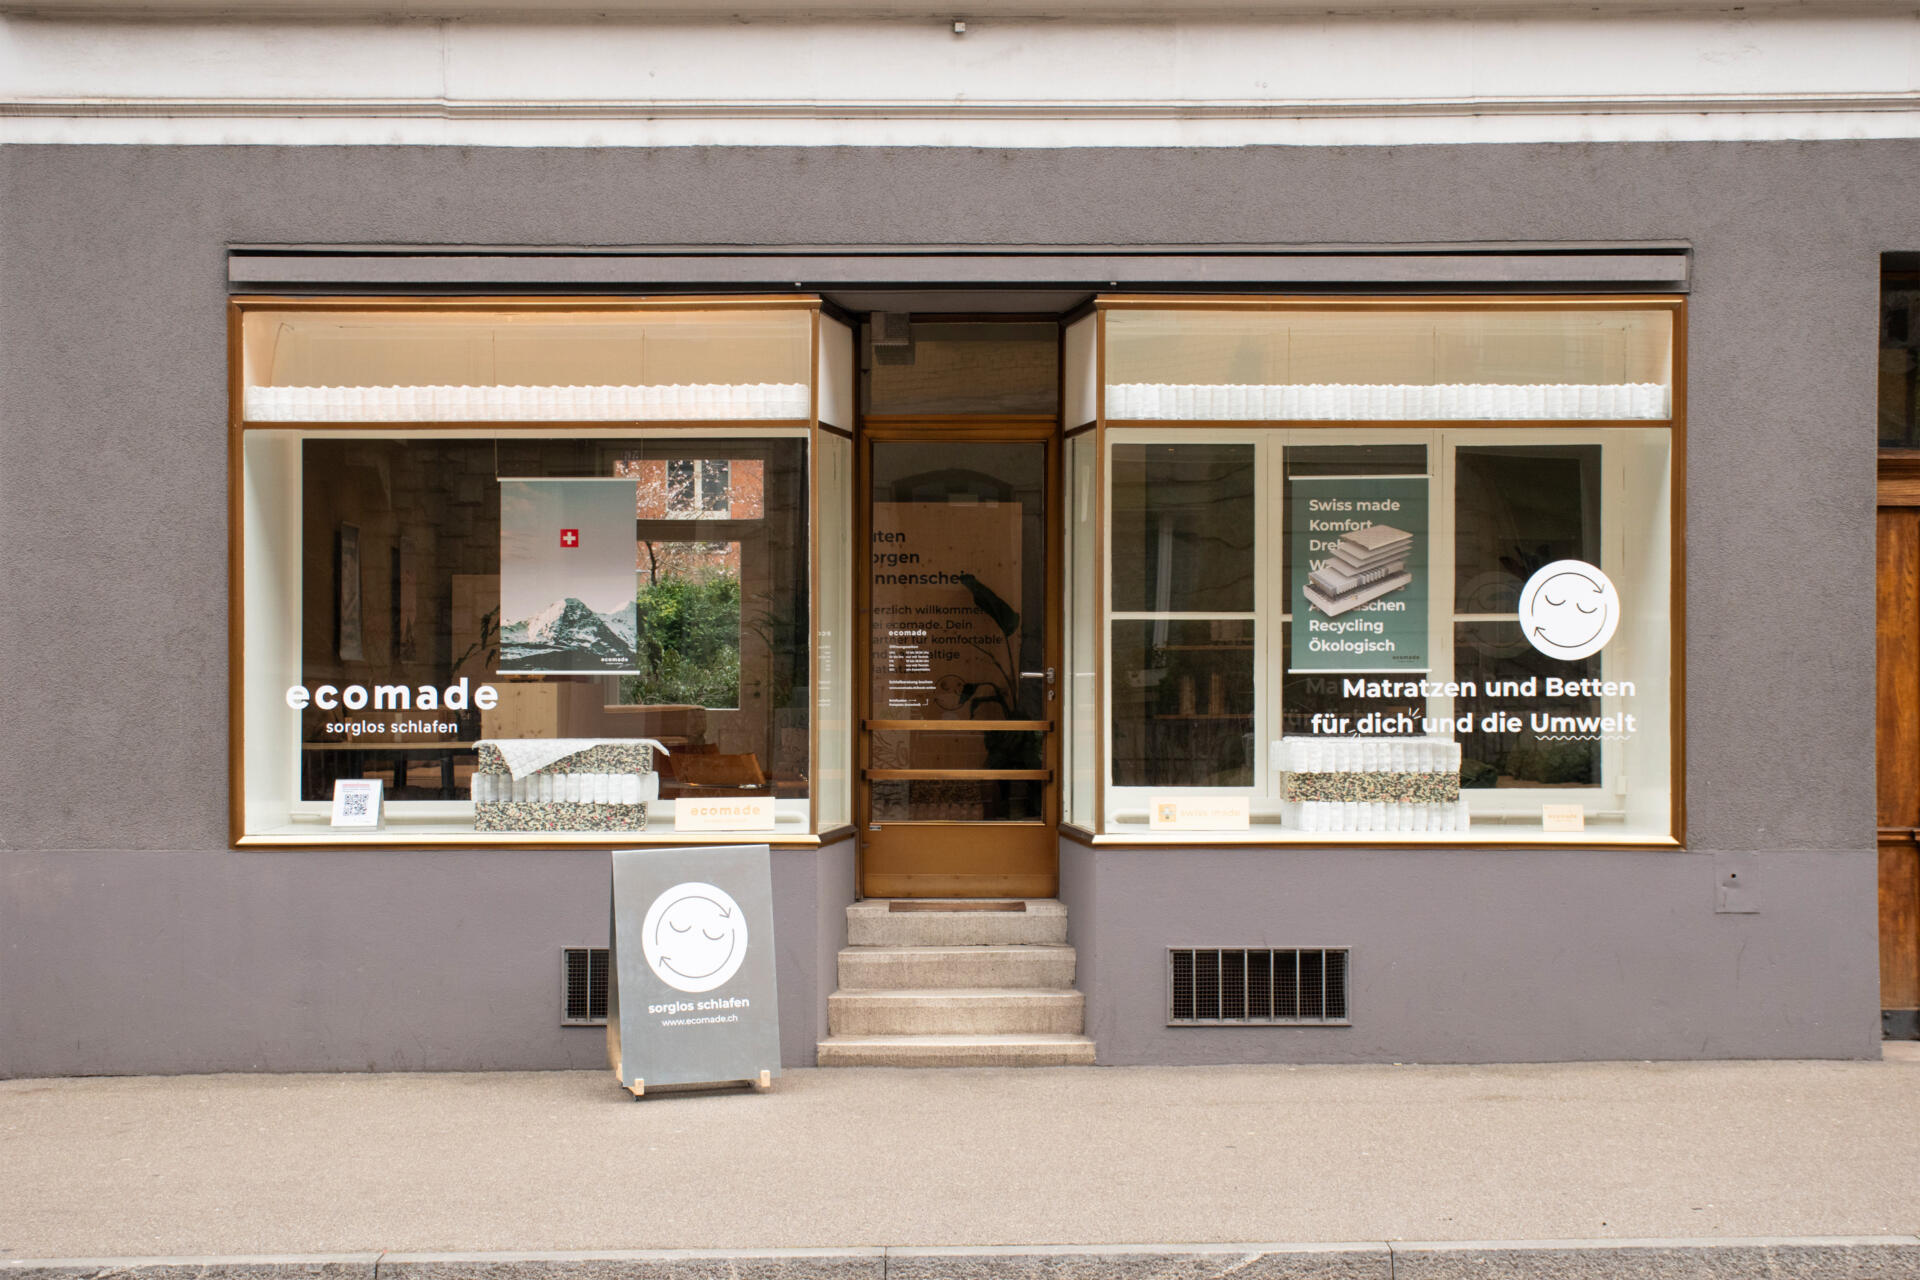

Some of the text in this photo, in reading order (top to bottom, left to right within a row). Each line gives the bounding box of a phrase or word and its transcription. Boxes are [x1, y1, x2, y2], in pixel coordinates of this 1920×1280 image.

[1309, 499, 1400, 511] Swiss made
[1309, 519, 1372, 531] Komfort
[1309, 619, 1384, 635] Recycling
[1309, 637, 1395, 654] Ökologisch
[286, 677, 499, 710] ecomade
[1343, 678, 1477, 698] Matratzen
[1485, 676, 1537, 697] und
[1545, 677, 1636, 697] Betten
[326, 720, 458, 736] sorglos schlafen
[1311, 712, 1351, 734] für
[1357, 712, 1413, 733] dich
[1421, 712, 1473, 733] und
[1481, 711, 1523, 733] die
[1530, 711, 1636, 733] Umwelt
[690, 804, 761, 817] ecomade
[648, 997, 750, 1014] sorglos schlafen
[661, 1014, 738, 1027] www.ecomade.ch
